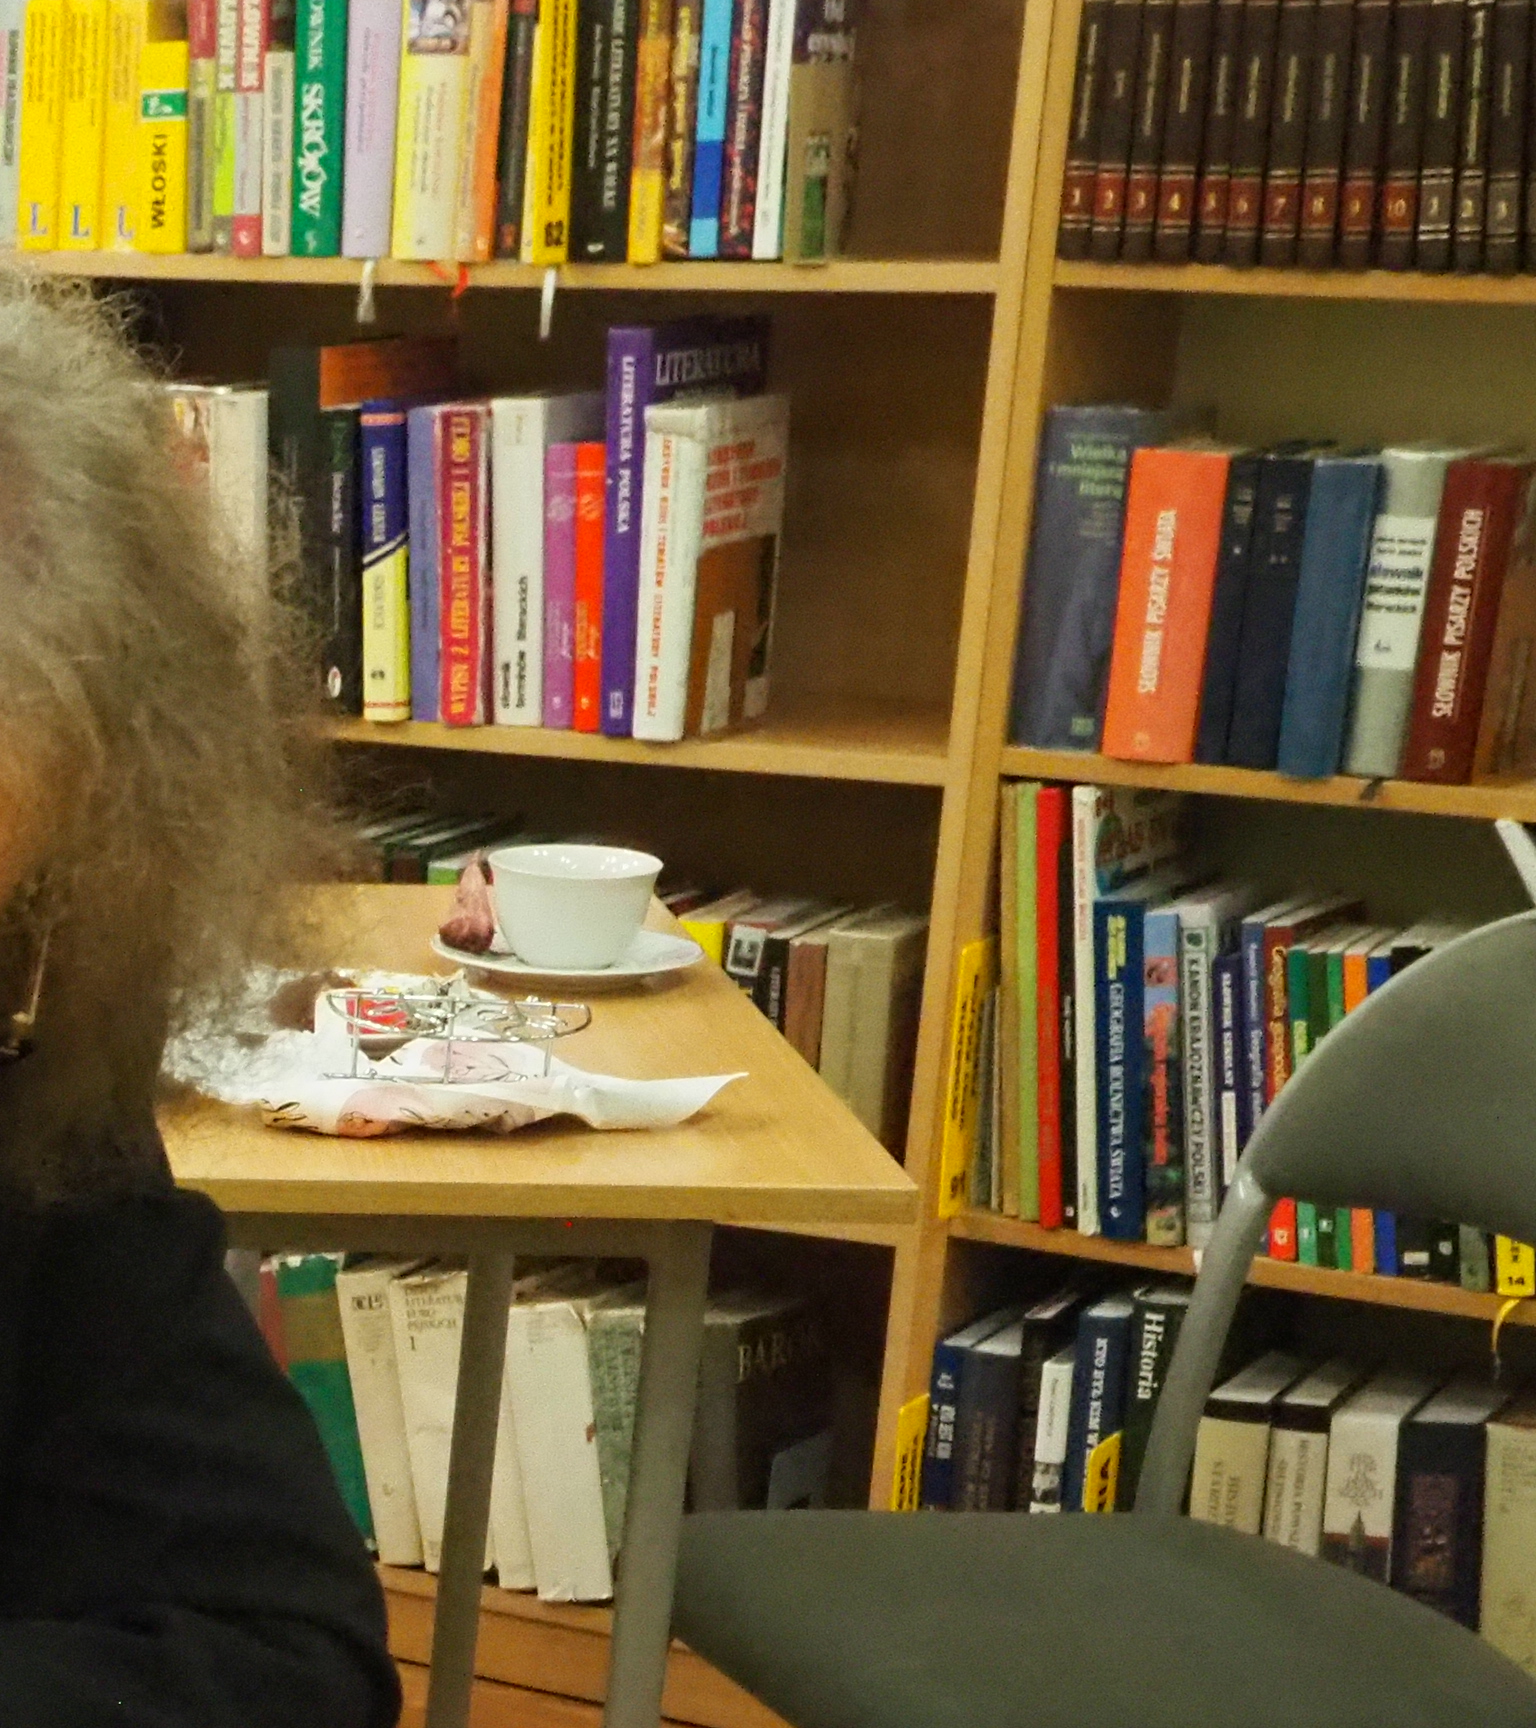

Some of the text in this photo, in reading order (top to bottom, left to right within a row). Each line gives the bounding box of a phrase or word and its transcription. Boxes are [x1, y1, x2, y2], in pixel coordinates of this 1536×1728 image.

[150, 132, 169, 229] WŁOSKI
[1386, 196, 1407, 217] 10
[615, 355, 634, 534] LITERATURA POLSKA
[1144, 565, 1170, 624] PISARZY
[1432, 509, 1484, 718] SŁOWNIK PISARZY POLSKICH
[1137, 629, 1163, 695] SŁOWNIK
[1108, 982, 1124, 1062] GEOGRAFIA
[1185, 956, 1208, 1195] KANON KRAJOZNAWCZY POLSKI
[1110, 1148, 1125, 1199] ŚWIATA
[1091, 1368, 1106, 1397] BYŁ
[1094, 1337, 1108, 1366] KTO
[1137, 1311, 1165, 1401] Historia
[1089, 1400, 1104, 1430] KIM
